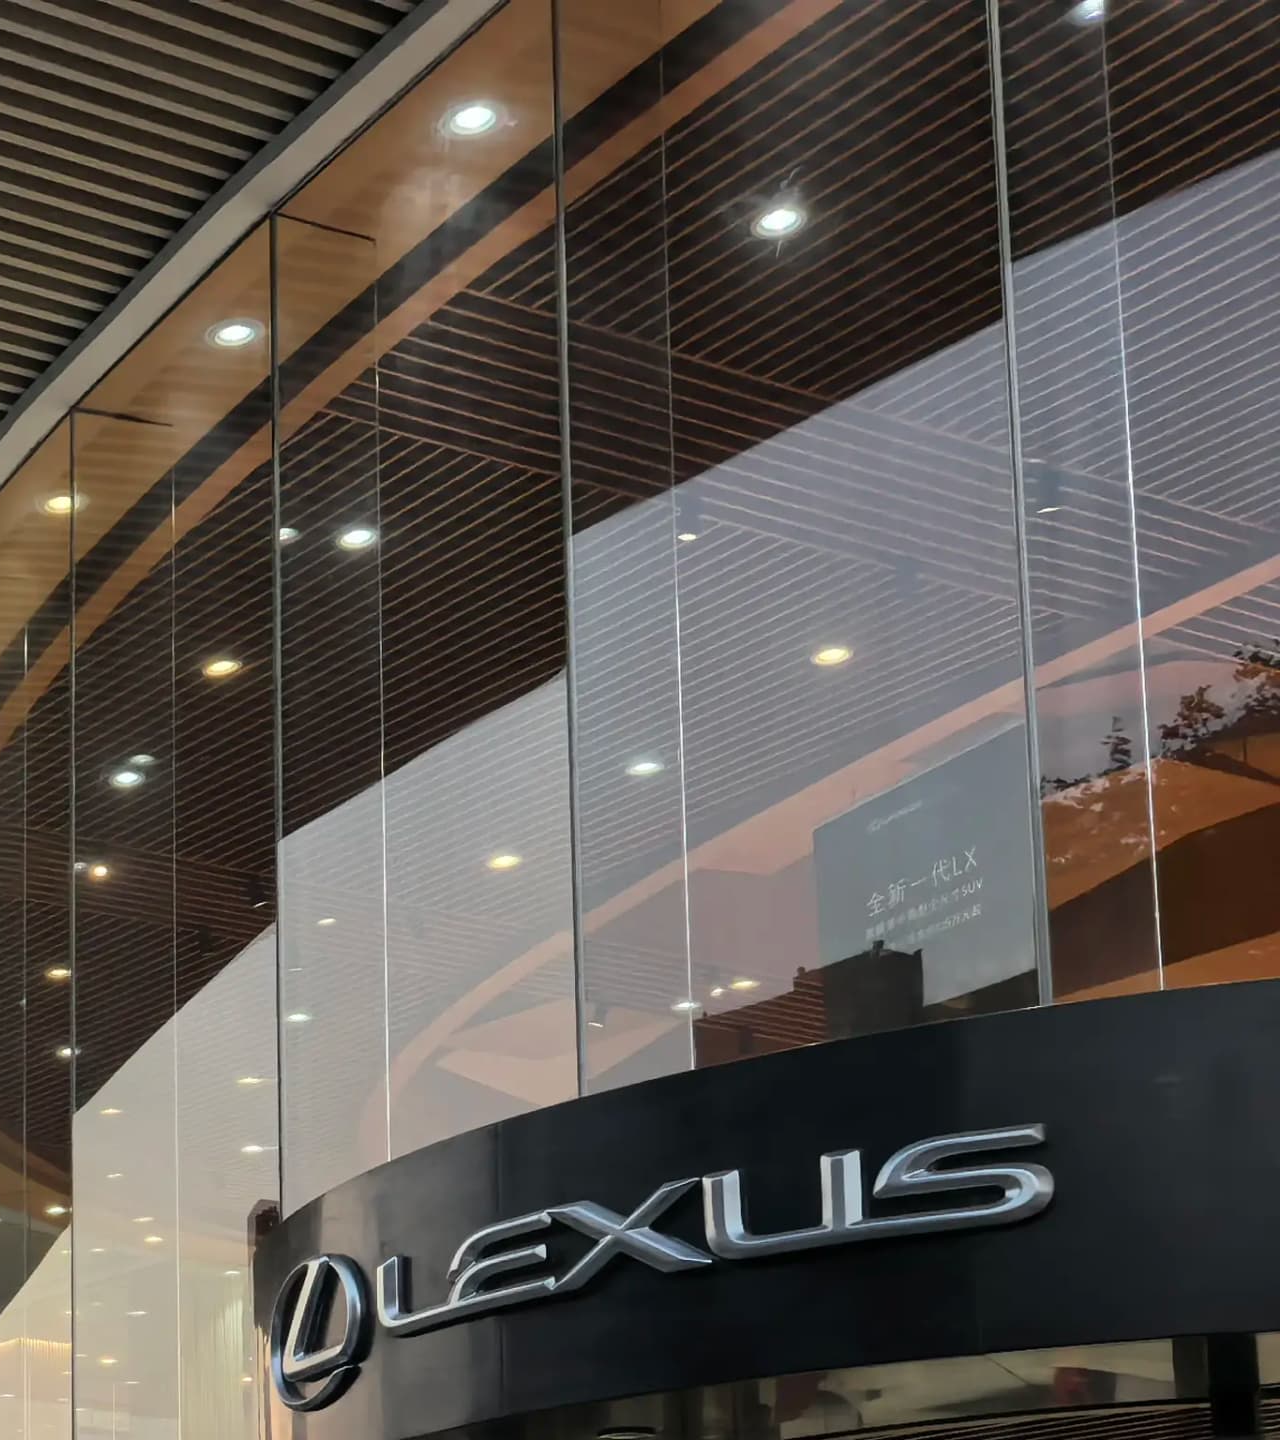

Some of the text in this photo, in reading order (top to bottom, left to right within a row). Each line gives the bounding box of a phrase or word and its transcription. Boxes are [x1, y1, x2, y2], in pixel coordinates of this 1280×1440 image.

[866, 845, 977, 917] 全新一代LX
[375, 1122, 1056, 1338] LEXUS
